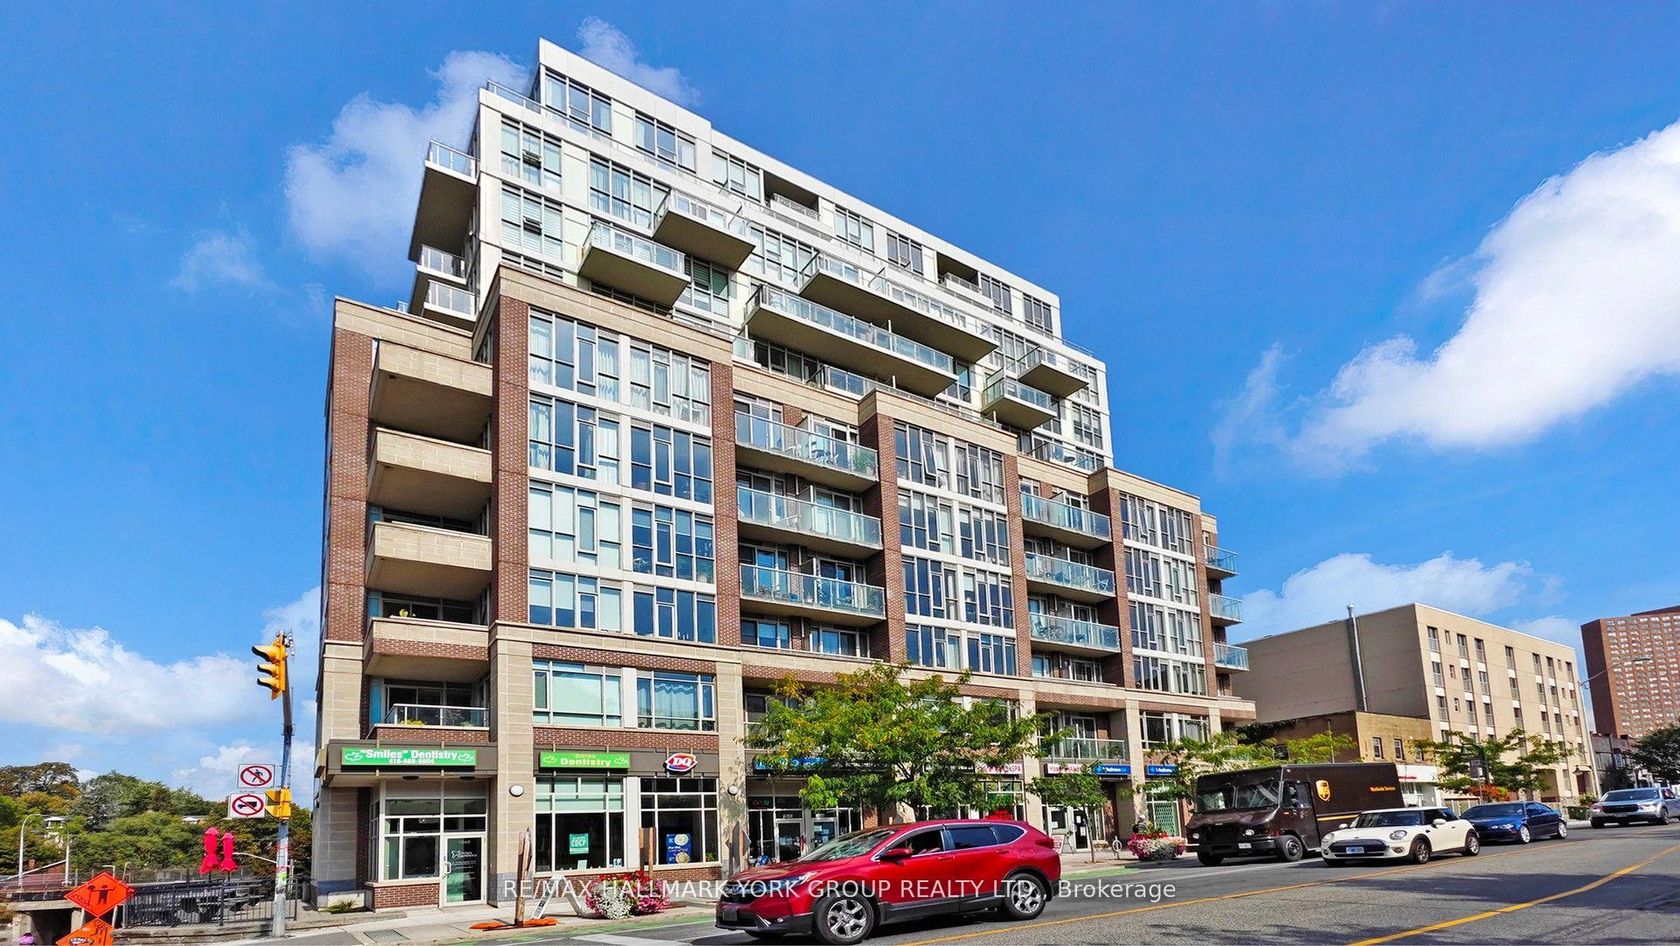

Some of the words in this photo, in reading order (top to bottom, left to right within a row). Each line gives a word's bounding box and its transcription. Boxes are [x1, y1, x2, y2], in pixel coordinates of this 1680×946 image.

[360, 749, 408, 759] "Smiles"
[411, 750, 458, 760] Dentistry
[561, 758, 611, 768] Dentistry
[672, 756, 692, 765] DQ
